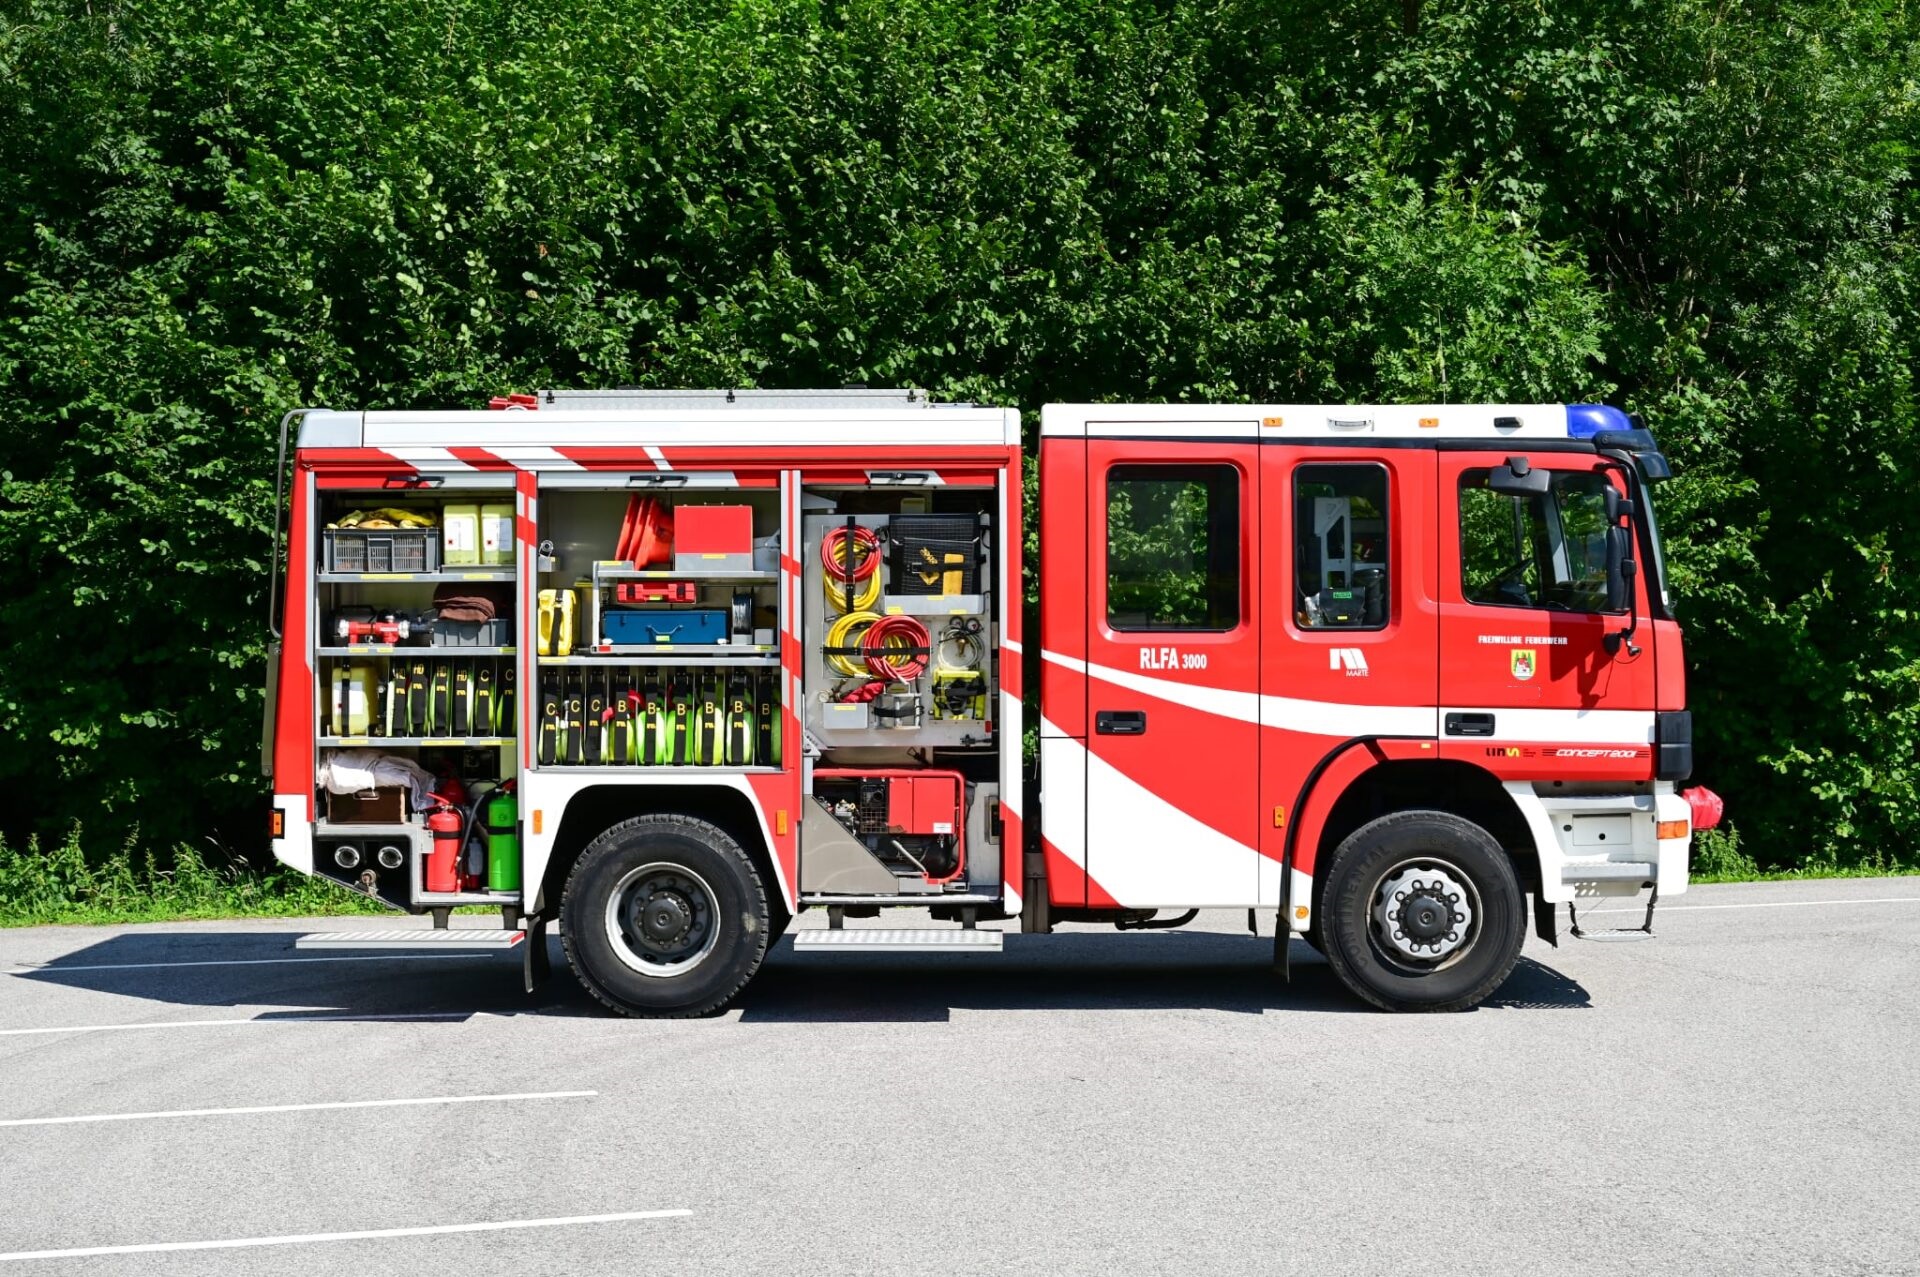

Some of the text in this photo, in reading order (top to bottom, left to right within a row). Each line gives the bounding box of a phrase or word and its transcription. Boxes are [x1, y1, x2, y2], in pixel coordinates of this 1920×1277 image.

[1478, 635, 1568, 645] FREIWILLIGE FEUERWEHR
[1140, 647, 1207, 670] RLFA 3000
[413, 663, 425, 675] HD
[436, 665, 447, 678] HD
[456, 669, 468, 682] HD
[480, 669, 490, 682] C
[505, 668, 514, 682] C
[546, 702, 556, 716] C
[570, 699, 580, 713] C
[591, 699, 601, 712] C
[617, 699, 627, 713] B
[647, 702, 656, 715] B
[677, 703, 686, 716] B
[705, 701, 714, 714] B
[734, 700, 743, 713] B
[762, 703, 770, 715] B
